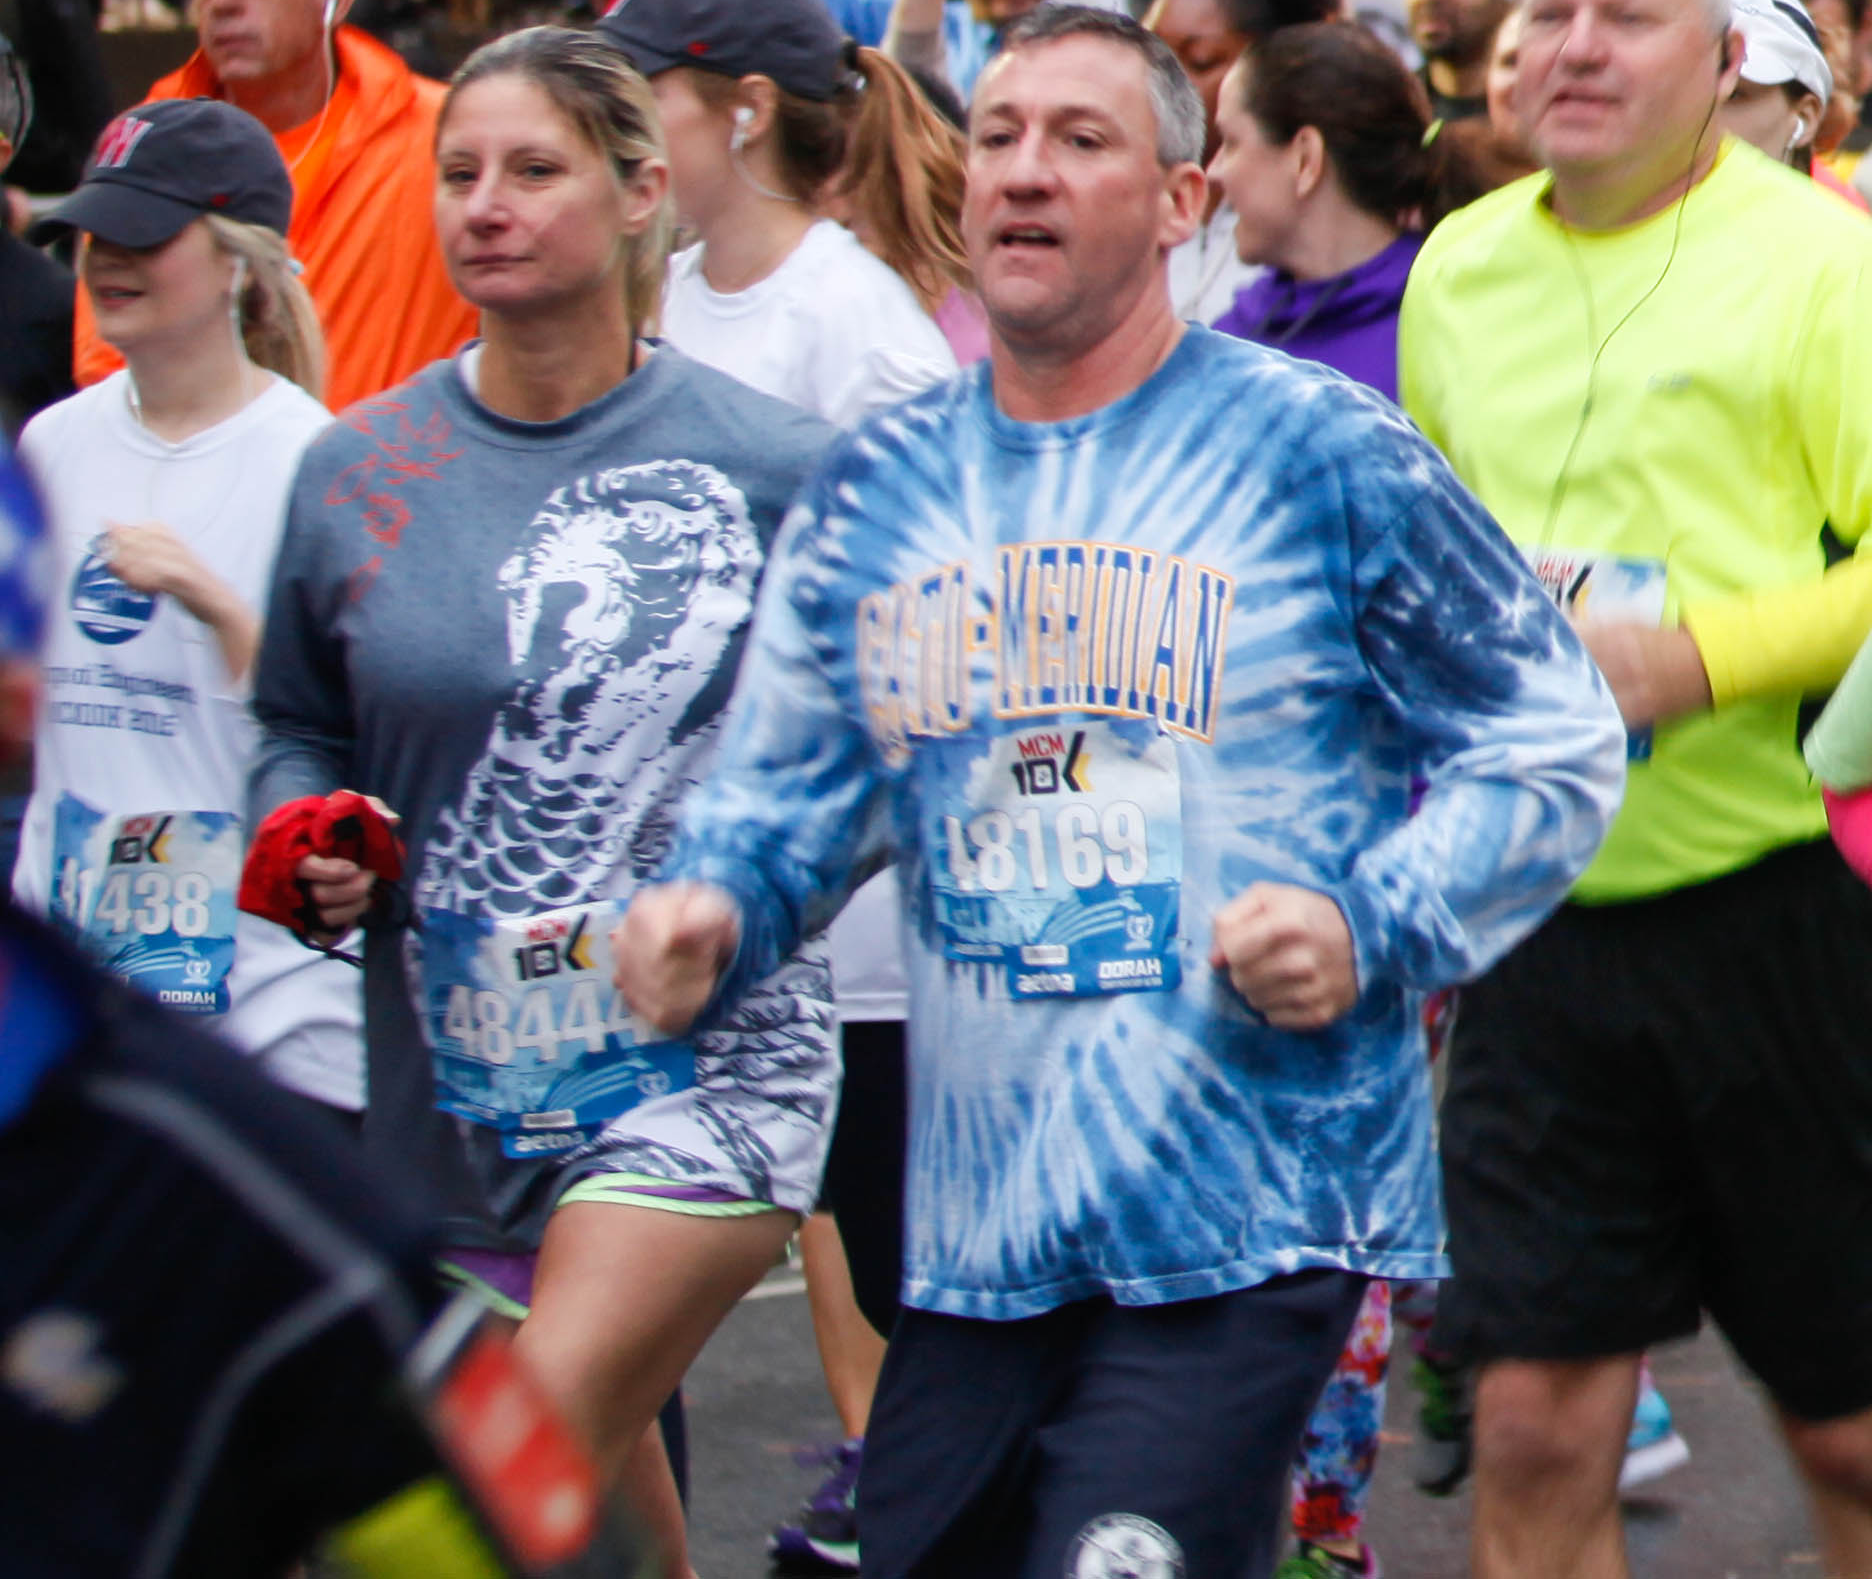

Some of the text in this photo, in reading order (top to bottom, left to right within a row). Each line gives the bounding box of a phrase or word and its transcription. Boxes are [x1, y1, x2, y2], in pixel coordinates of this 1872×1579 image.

[1010, 731, 1093, 796] 10K
[1018, 733, 1066, 758] MCM
[944, 800, 1149, 893] 48169
[515, 914, 597, 981] 10K
